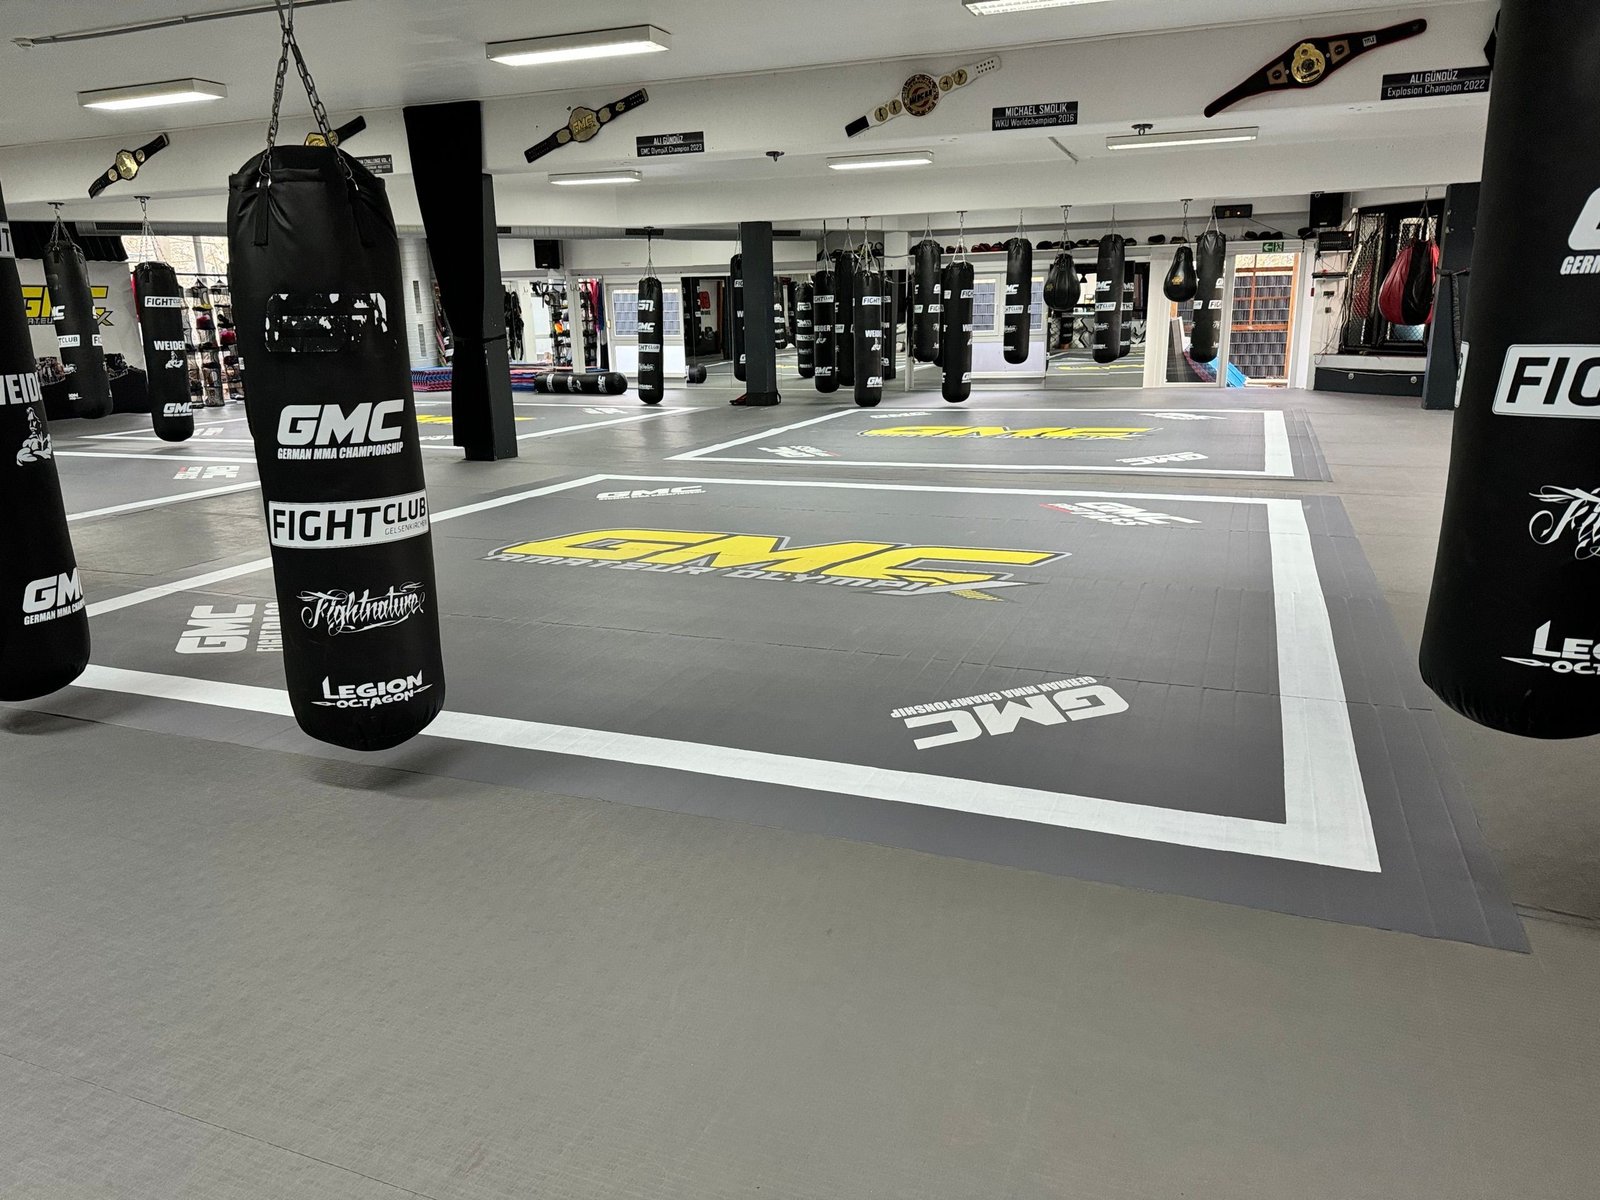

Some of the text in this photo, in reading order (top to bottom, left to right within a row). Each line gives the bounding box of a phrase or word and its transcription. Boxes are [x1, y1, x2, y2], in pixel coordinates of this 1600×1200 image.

[1409, 69, 1458, 84] ALI GÜNDÜZ
[1387, 80, 1485, 97] Explosion Champion 2022
[1005, 103, 1067, 117] MICHAEL SMOLIK
[994, 113, 1075, 128] WKU Worldchampion 2016
[653, 137, 662, 146] ALI
[668, 145, 690, 153] Champion
[866, 376, 883, 385] GM
[163, 402, 193, 413] GMC
[277, 399, 404, 446] GMC
[277, 441, 404, 460] GERMAN MMA CHAMPIONSHIP
[384, 519, 427, 536] GELSENKIRCHEN
[482, 554, 713, 575] AMATEUR
[488, 528, 1072, 586] GMC
[23, 567, 83, 614] GM
[24, 610, 56, 626] GERMAN
[57, 605, 71, 618] MMA
[296, 581, 426, 636] Fightnature
[175, 604, 257, 654] GMC
[322, 669, 423, 699] LEGION
[336, 690, 414, 709] OCTAGON
[890, 676, 1098, 718] GERMAN MMA CHAMPIONSHIP
[904, 685, 1130, 750] GMC
